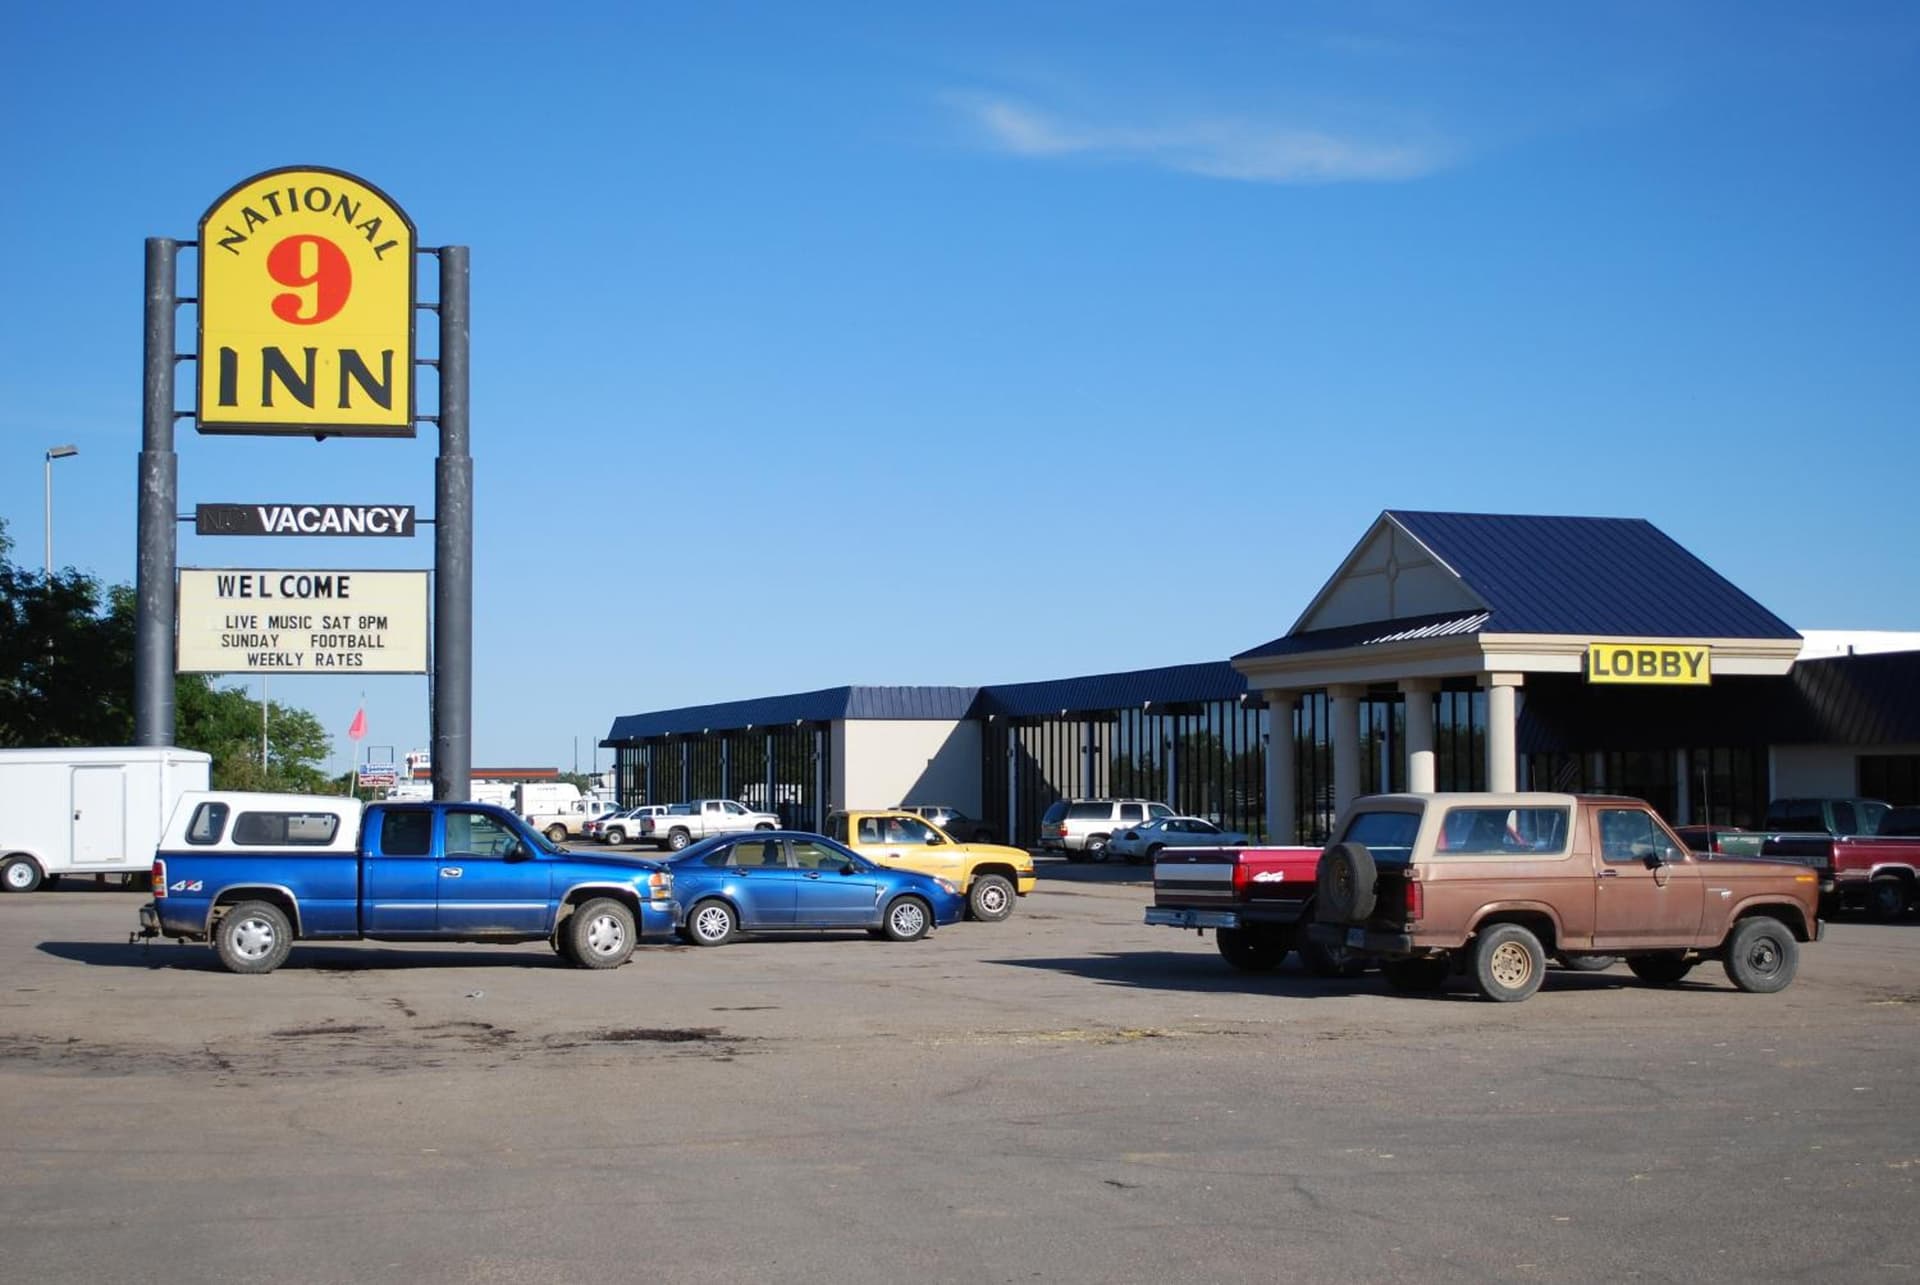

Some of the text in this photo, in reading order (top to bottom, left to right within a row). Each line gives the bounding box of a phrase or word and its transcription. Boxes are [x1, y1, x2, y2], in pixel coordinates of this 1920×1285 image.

[217, 186, 399, 261] NATIONAL
[266, 234, 352, 326] 9
[218, 346, 394, 411] INN
[257, 506, 409, 533] VACANCY
[217, 575, 350, 598] WELCOME
[225, 615, 388, 630] LIVE MUSIC SAT 8PM
[221, 634, 385, 649] SUNDAY FOOTBALL
[247, 652, 363, 667] WEEKLY RATES
[1593, 649, 1704, 678] LOBBY
